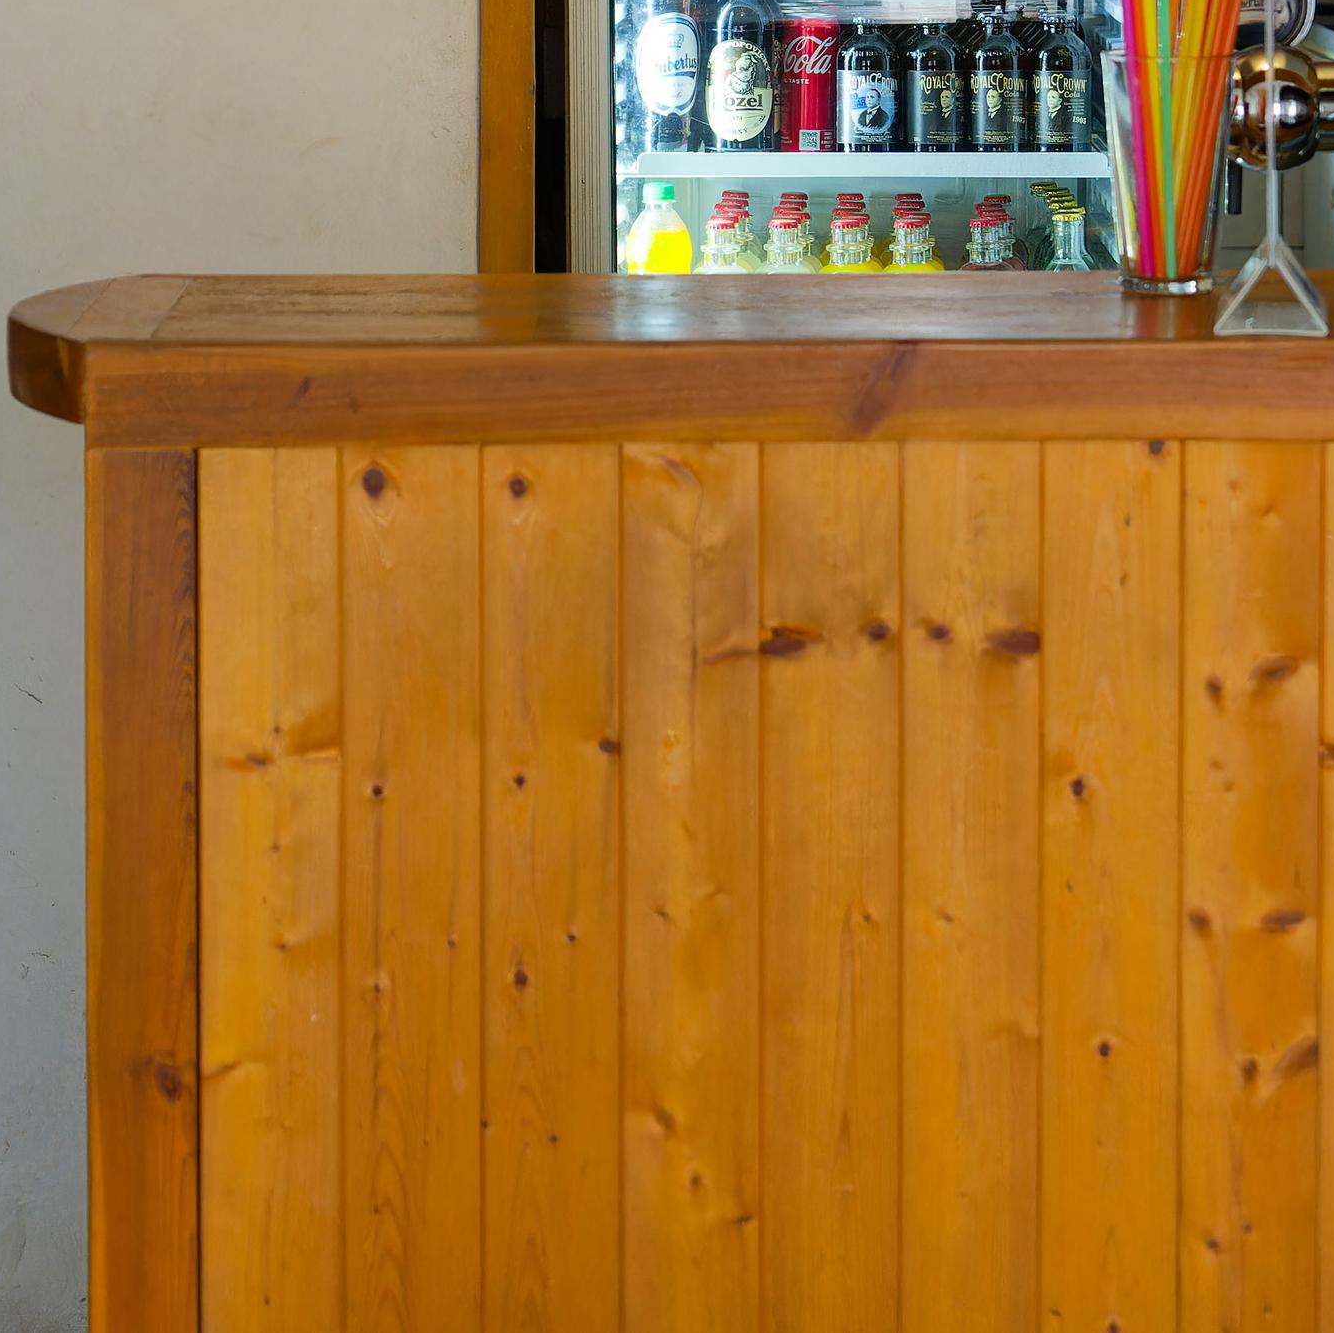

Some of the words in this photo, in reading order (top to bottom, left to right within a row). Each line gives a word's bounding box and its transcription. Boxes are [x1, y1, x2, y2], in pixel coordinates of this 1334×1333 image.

[783, 36, 837, 75] Cola
[920, 74, 947, 95] ROYAL
[990, 72, 1025, 94] CROWN
[1051, 72, 1087, 94] CROWN
